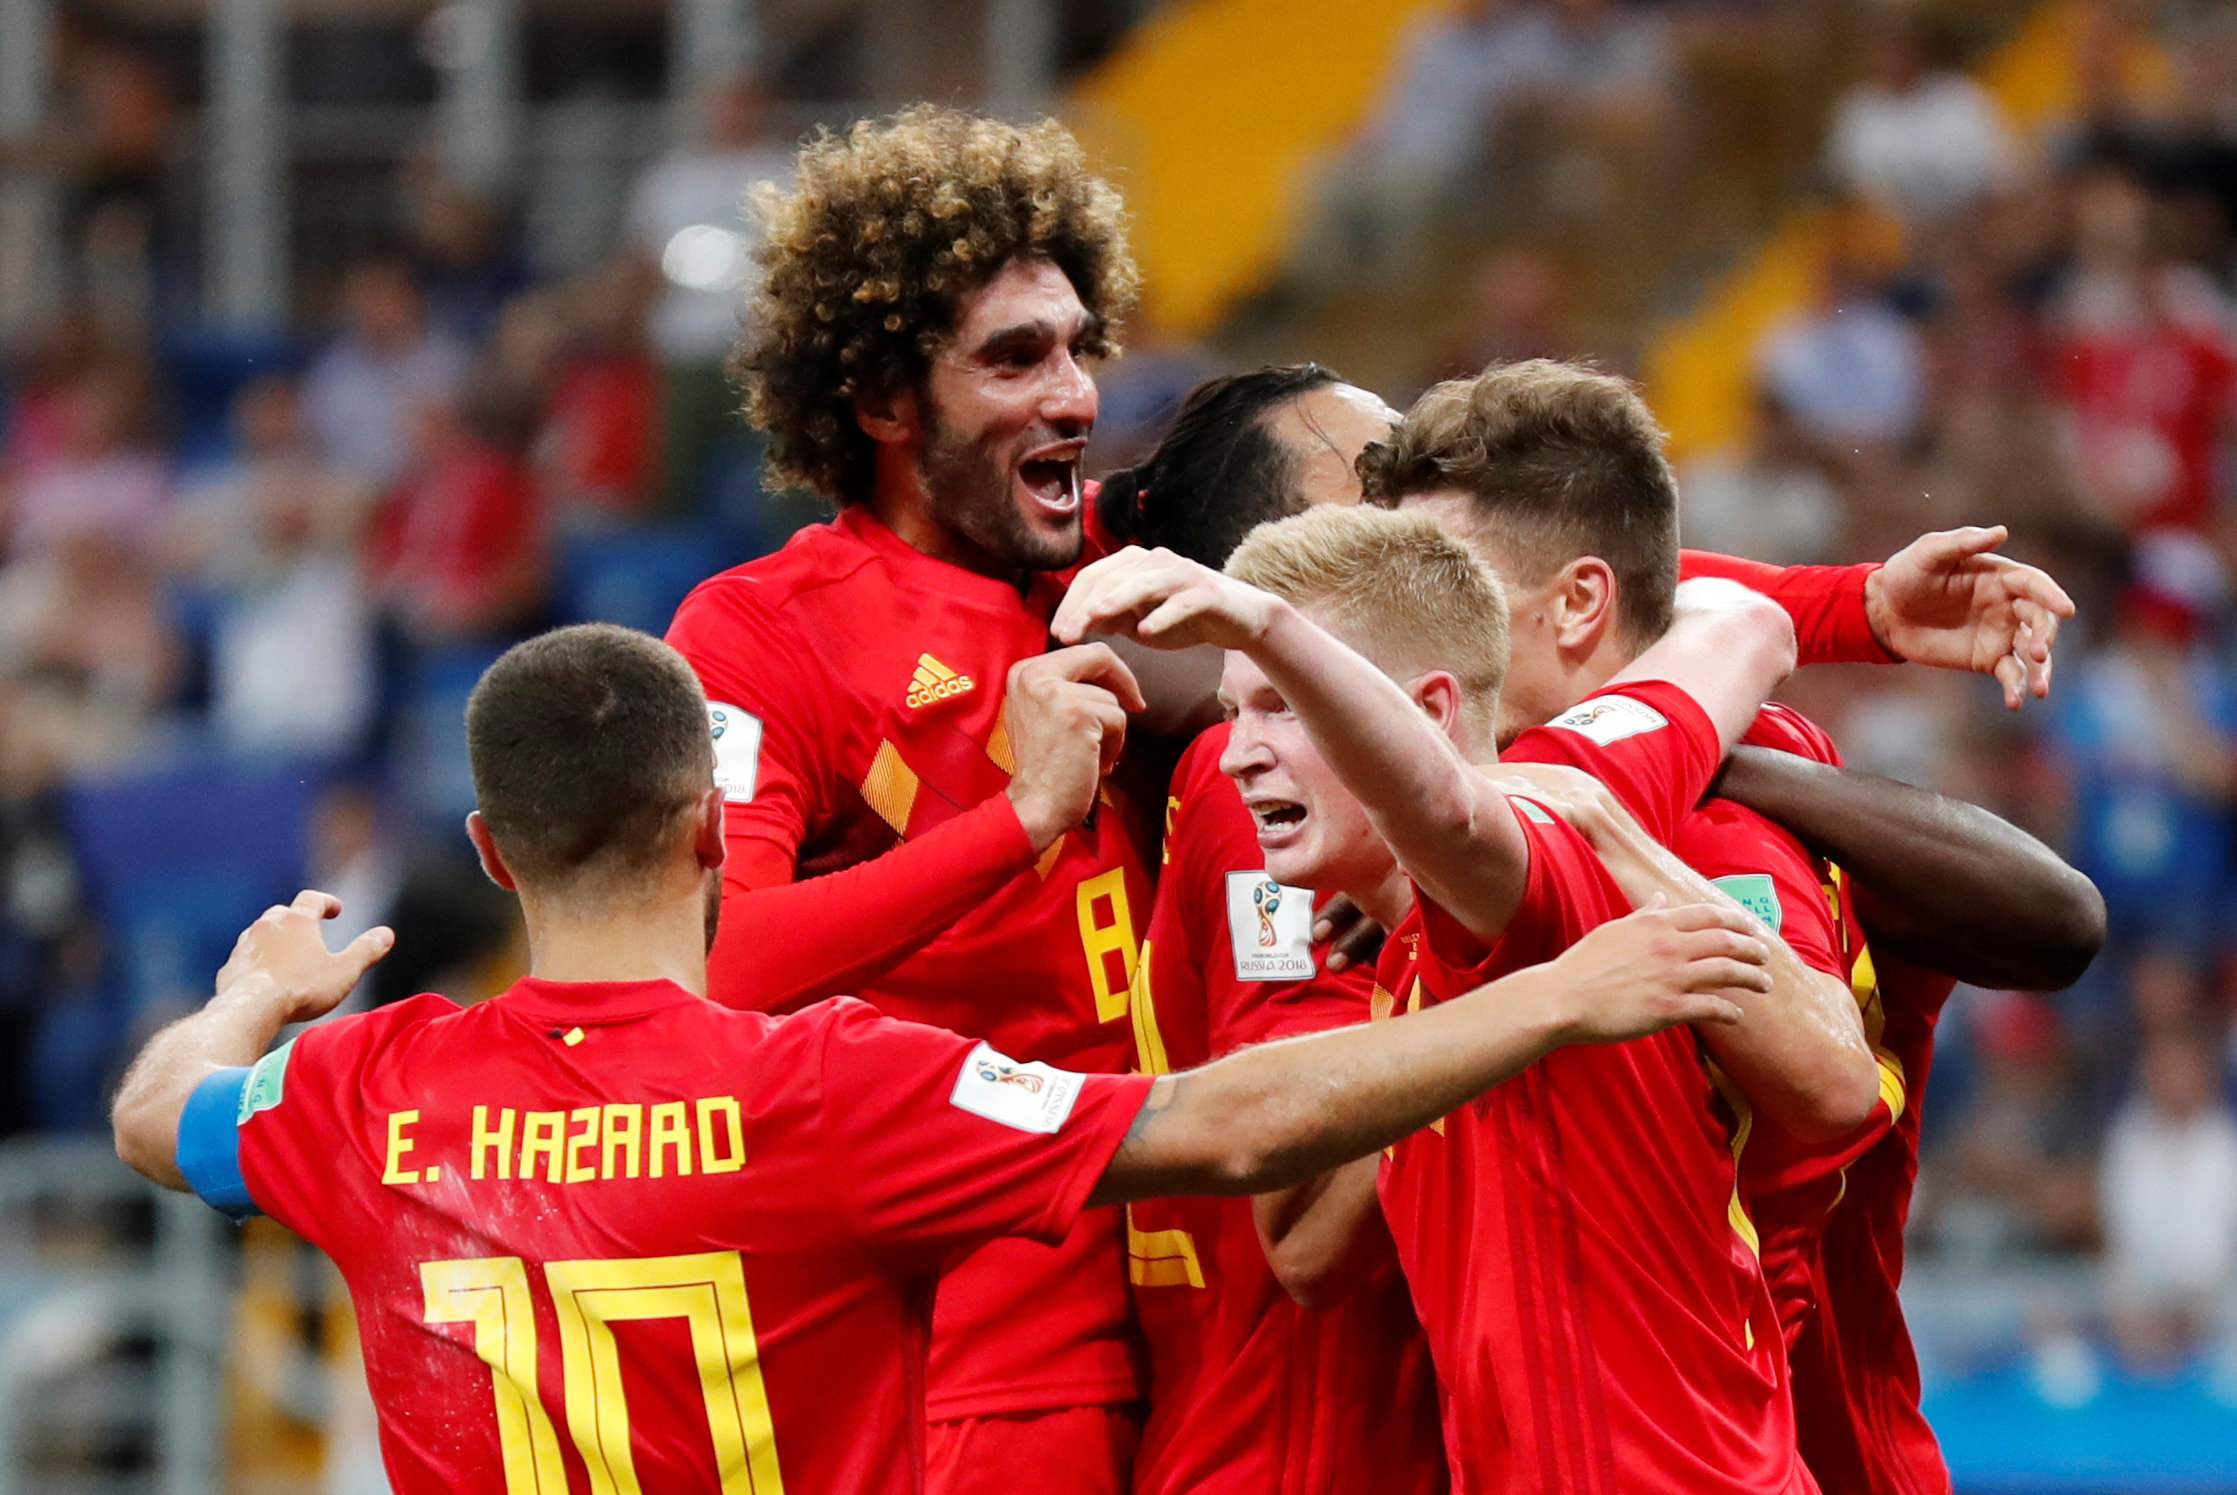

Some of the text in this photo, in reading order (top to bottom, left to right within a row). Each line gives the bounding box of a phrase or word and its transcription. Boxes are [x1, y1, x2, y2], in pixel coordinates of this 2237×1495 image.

[905, 675, 974, 708] adidas
[1076, 866, 1139, 1024] 8
[1240, 960, 1307, 971] RUSSIA 2018
[381, 1096, 746, 1184] E. HAZARD
[420, 1251, 785, 1495] 10
